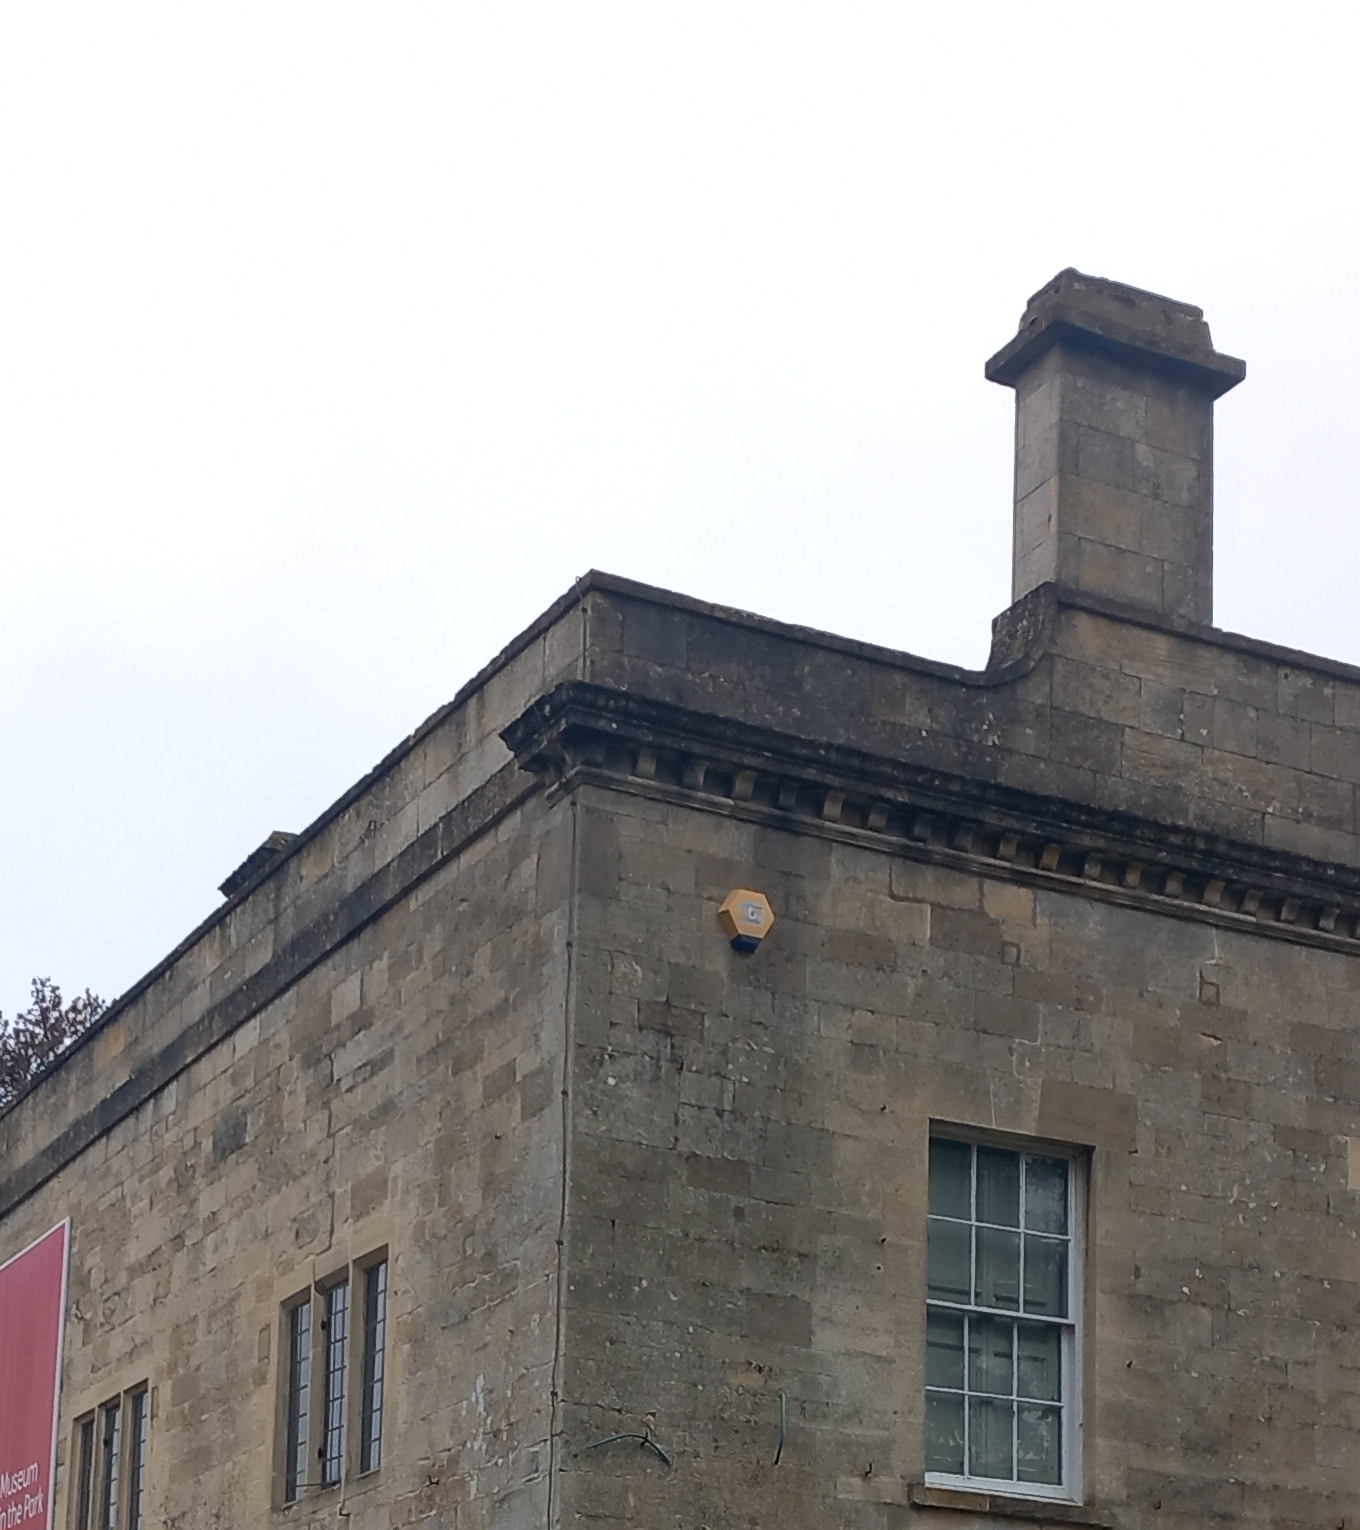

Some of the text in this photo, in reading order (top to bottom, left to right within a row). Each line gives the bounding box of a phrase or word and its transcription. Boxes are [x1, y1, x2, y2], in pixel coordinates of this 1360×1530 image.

[0, 1462, 38, 1499] Museum
[7, 1500, 22, 1528] the
[23, 1485, 44, 1520] Park
